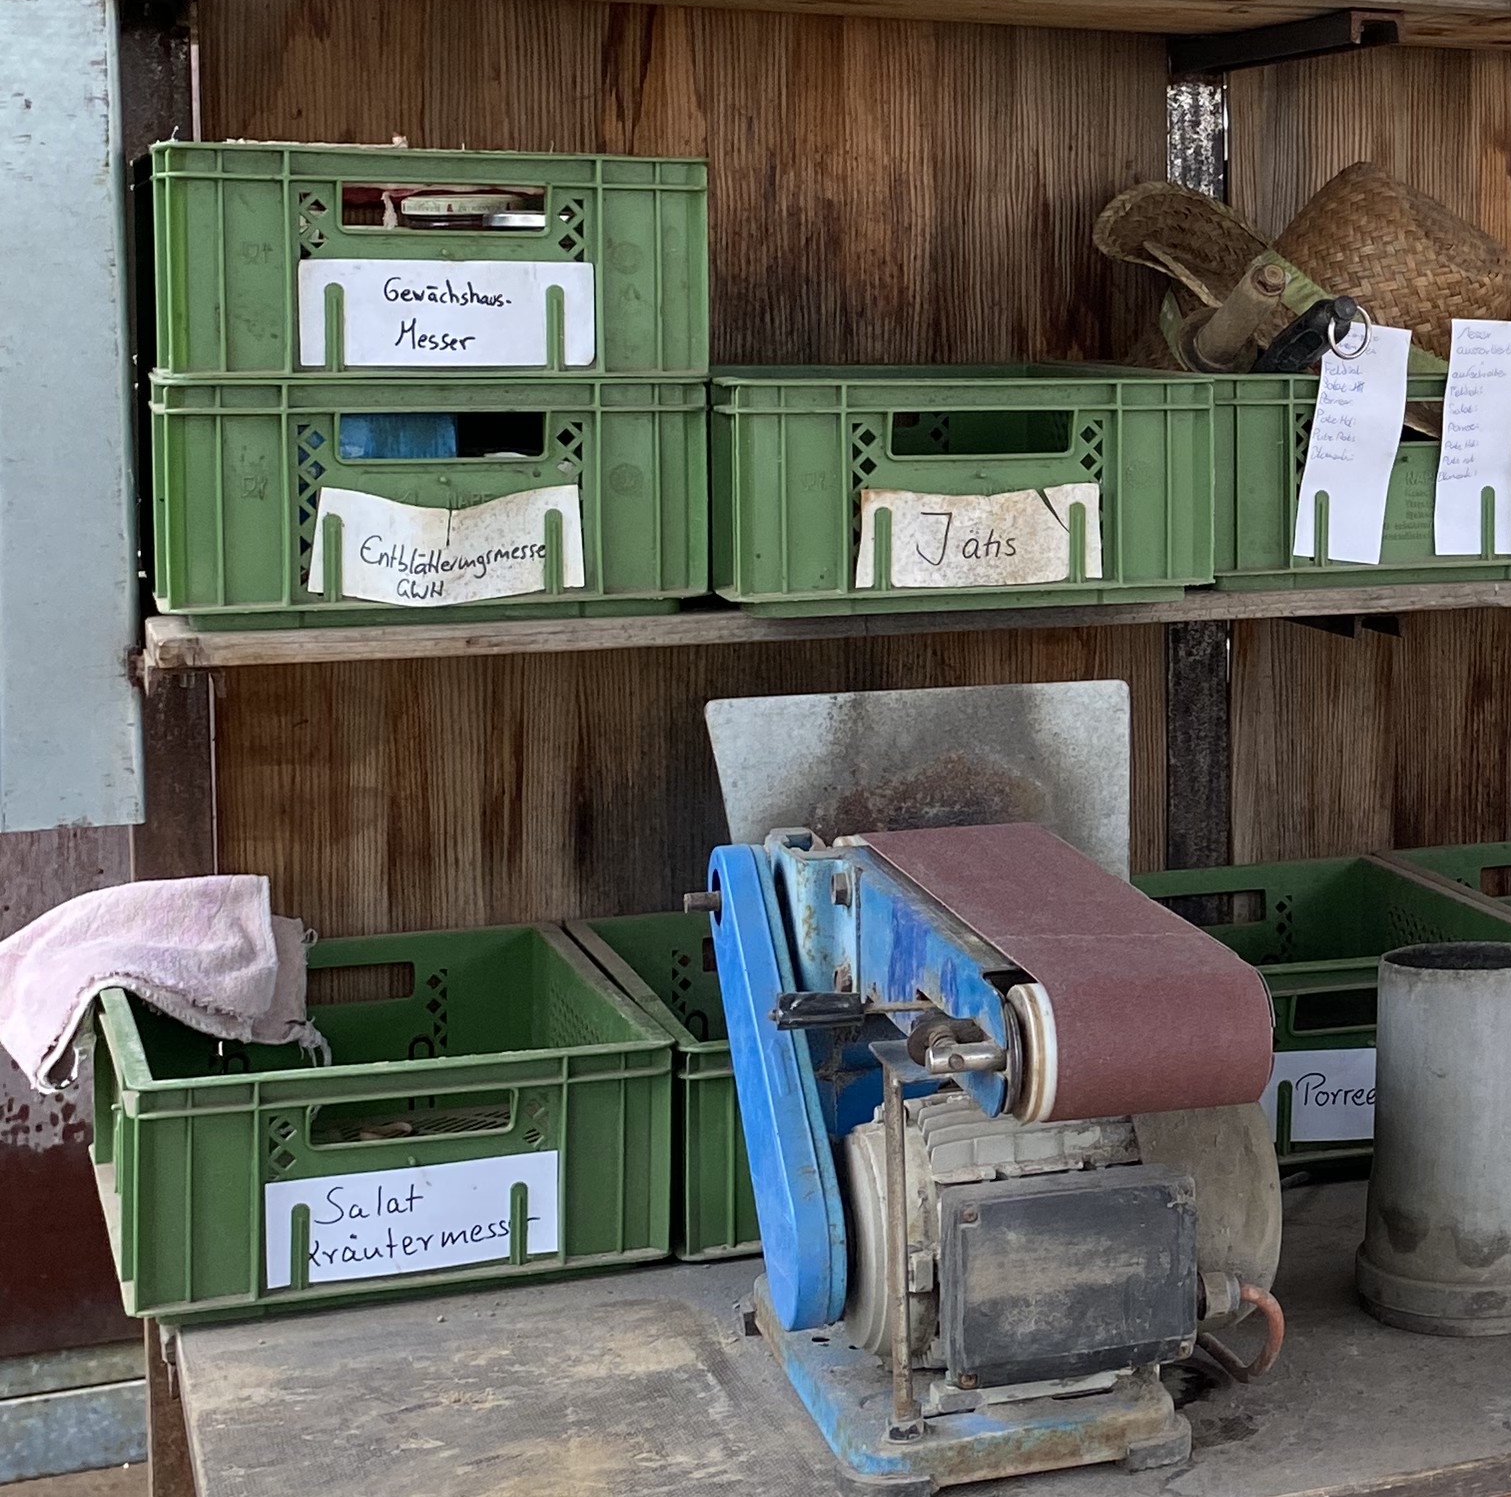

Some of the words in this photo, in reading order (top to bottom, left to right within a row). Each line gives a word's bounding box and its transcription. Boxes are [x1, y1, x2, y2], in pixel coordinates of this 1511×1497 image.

[395, 318, 475, 350] Messer
[1296, 1072, 1376, 1107] Porree
[314, 1184, 424, 1225] Salat
